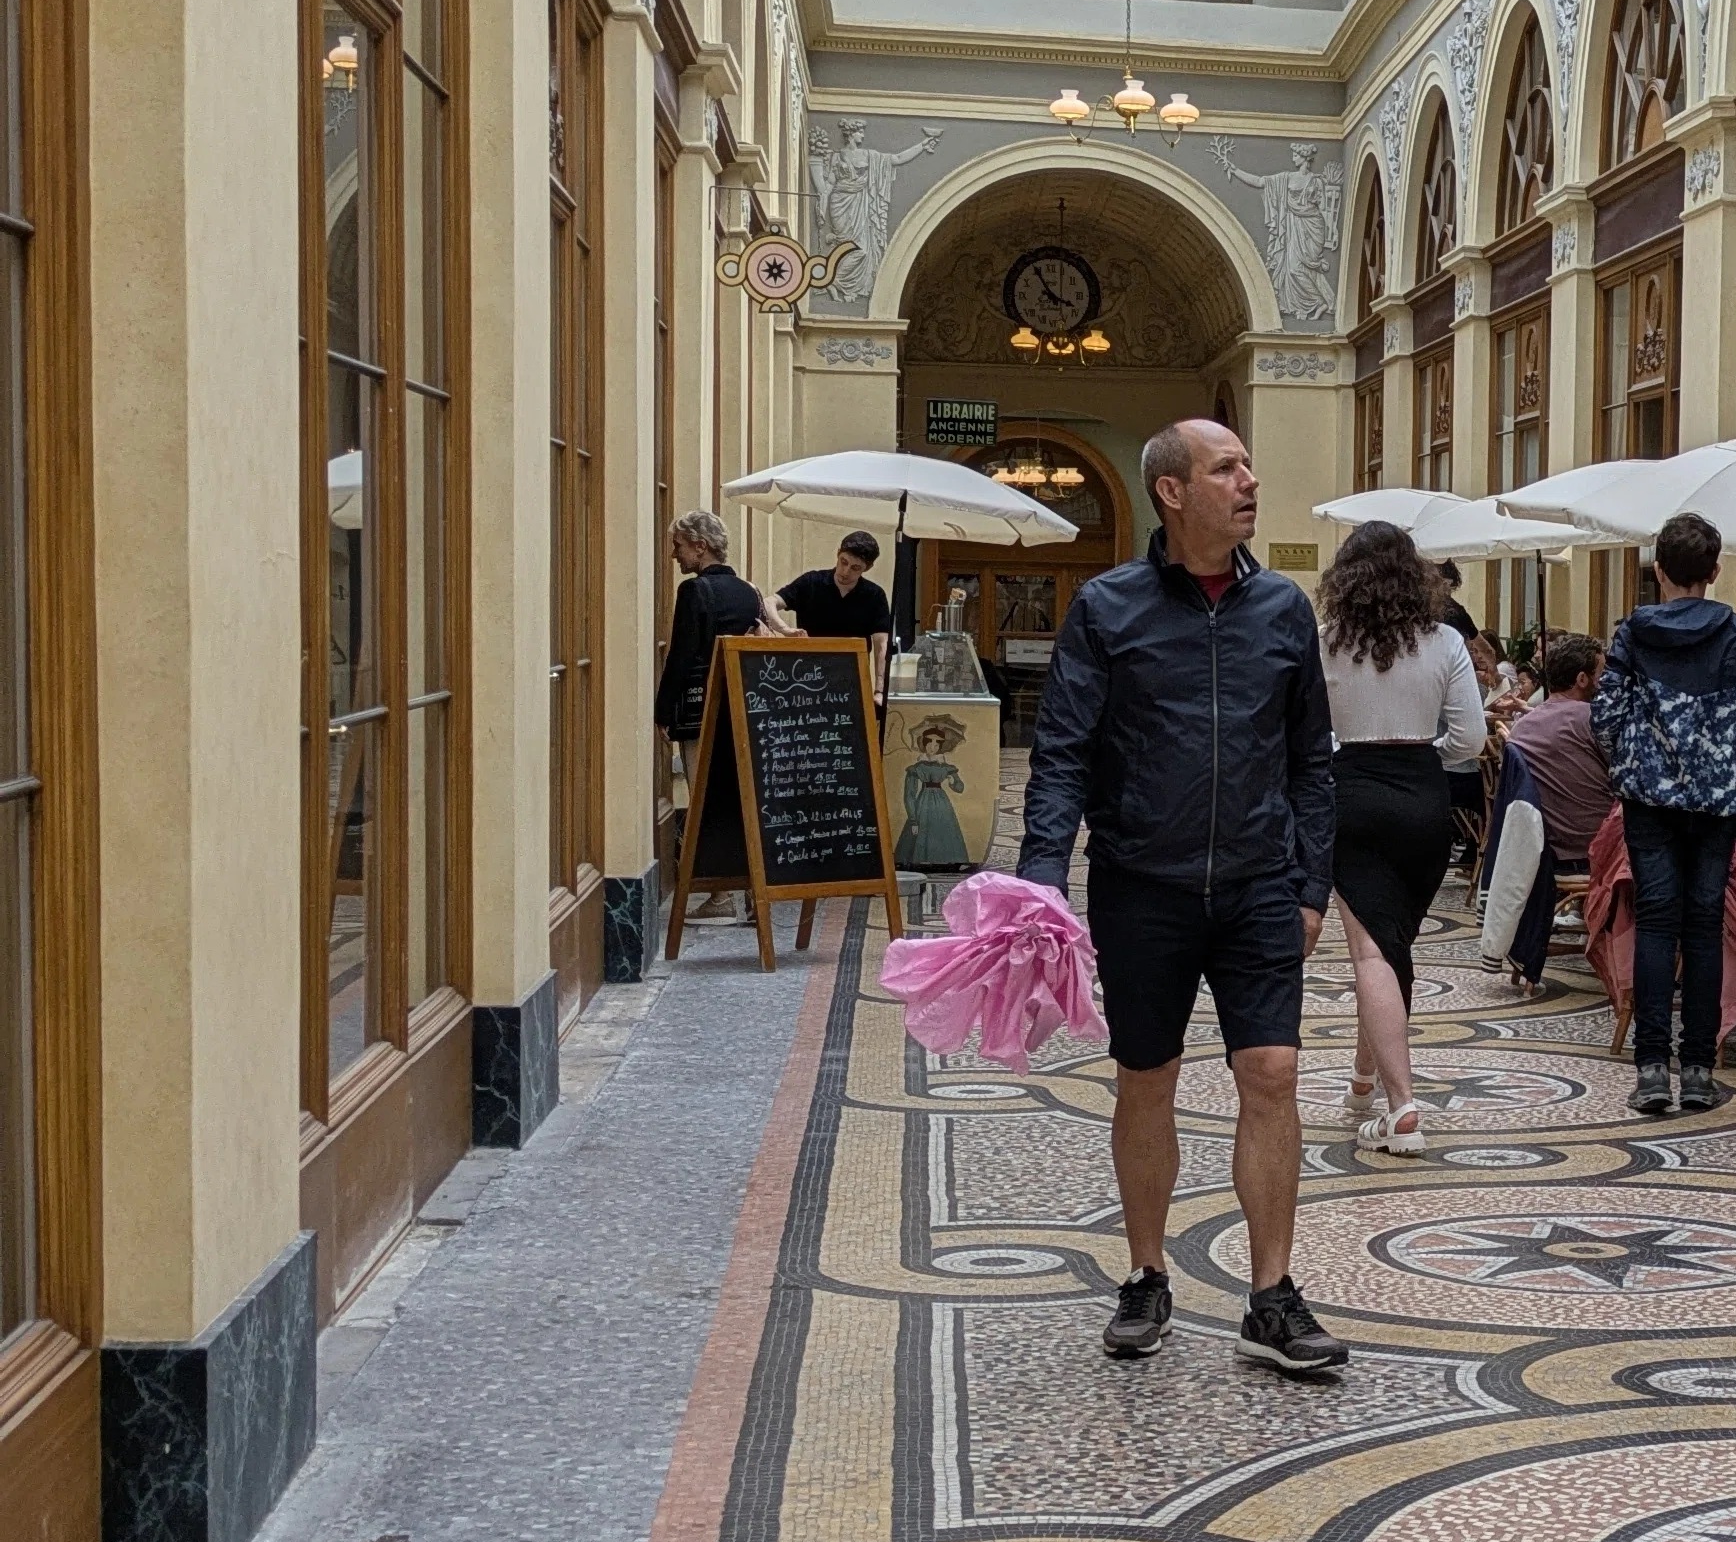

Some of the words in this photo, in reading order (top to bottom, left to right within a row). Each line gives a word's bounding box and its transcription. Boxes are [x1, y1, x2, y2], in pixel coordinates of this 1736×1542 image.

[929, 402, 996, 421] LIBRAIRIE
[929, 421, 995, 433] ANCIENNE
[928, 432, 994, 445] MODERNE
[759, 655, 788, 681] La
[791, 659, 824, 682] Carte
